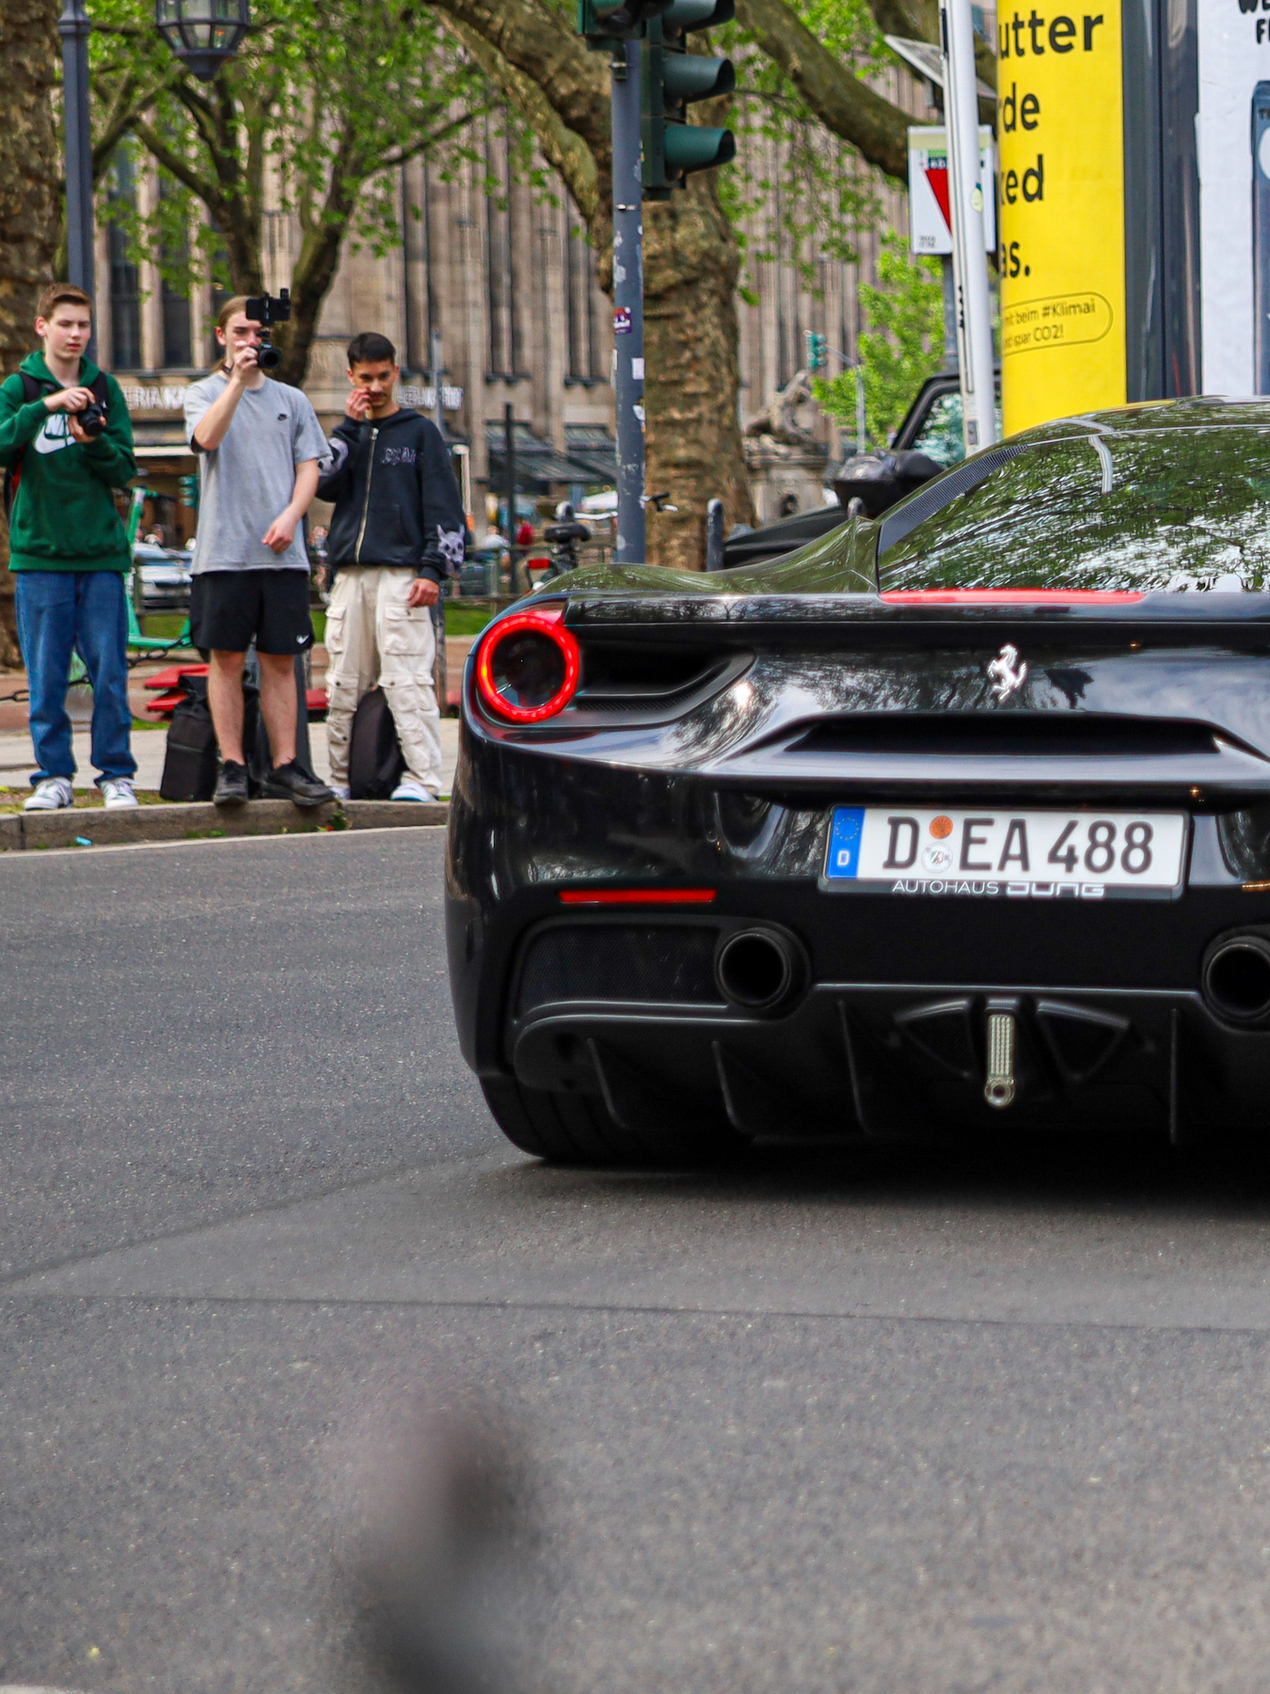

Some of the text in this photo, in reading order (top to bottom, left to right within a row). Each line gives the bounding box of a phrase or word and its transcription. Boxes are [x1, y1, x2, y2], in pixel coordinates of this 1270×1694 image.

[1032, 322, 1065, 342] CO2!
[882, 815, 1154, 875] D EA 488
[836, 849, 850, 868] D
[892, 879, 1000, 895] AUTOHAUS
